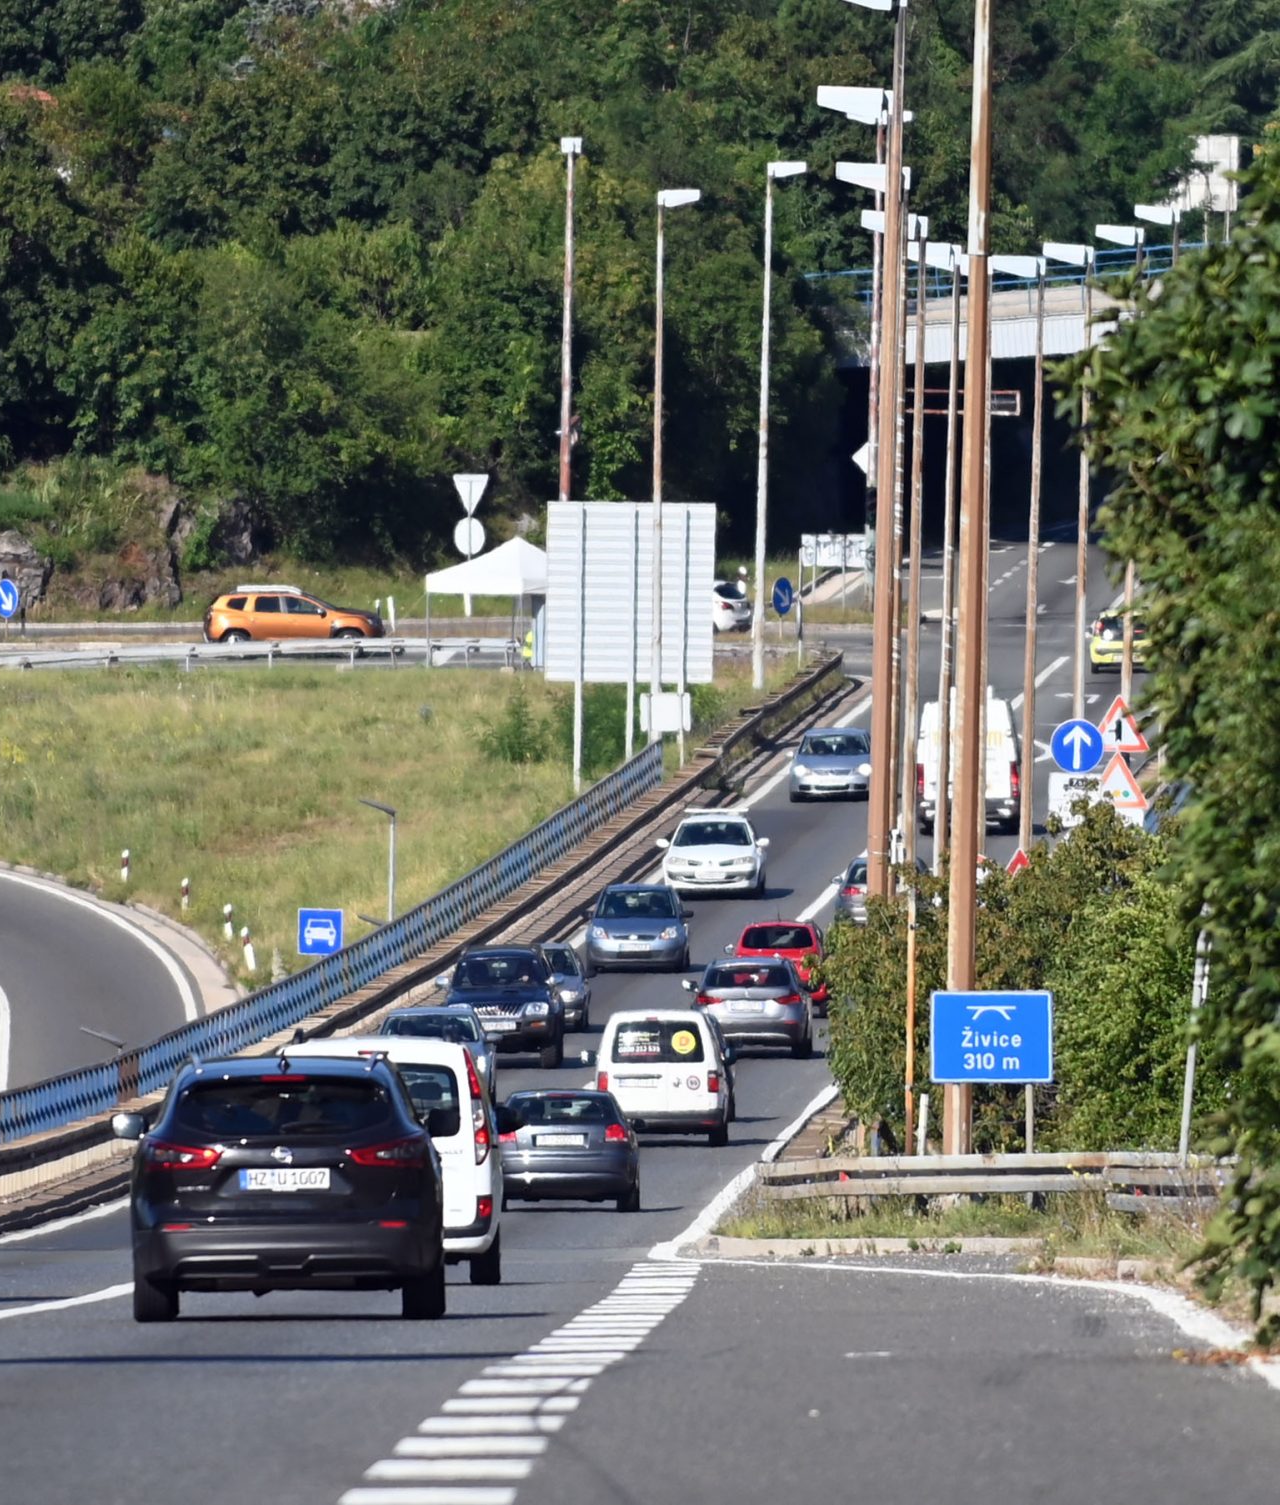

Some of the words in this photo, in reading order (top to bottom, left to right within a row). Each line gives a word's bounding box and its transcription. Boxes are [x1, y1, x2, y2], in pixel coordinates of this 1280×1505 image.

[961, 1026, 1022, 1048] Živice
[963, 1052, 995, 1070] 310
[1002, 1056, 1020, 1070] m
